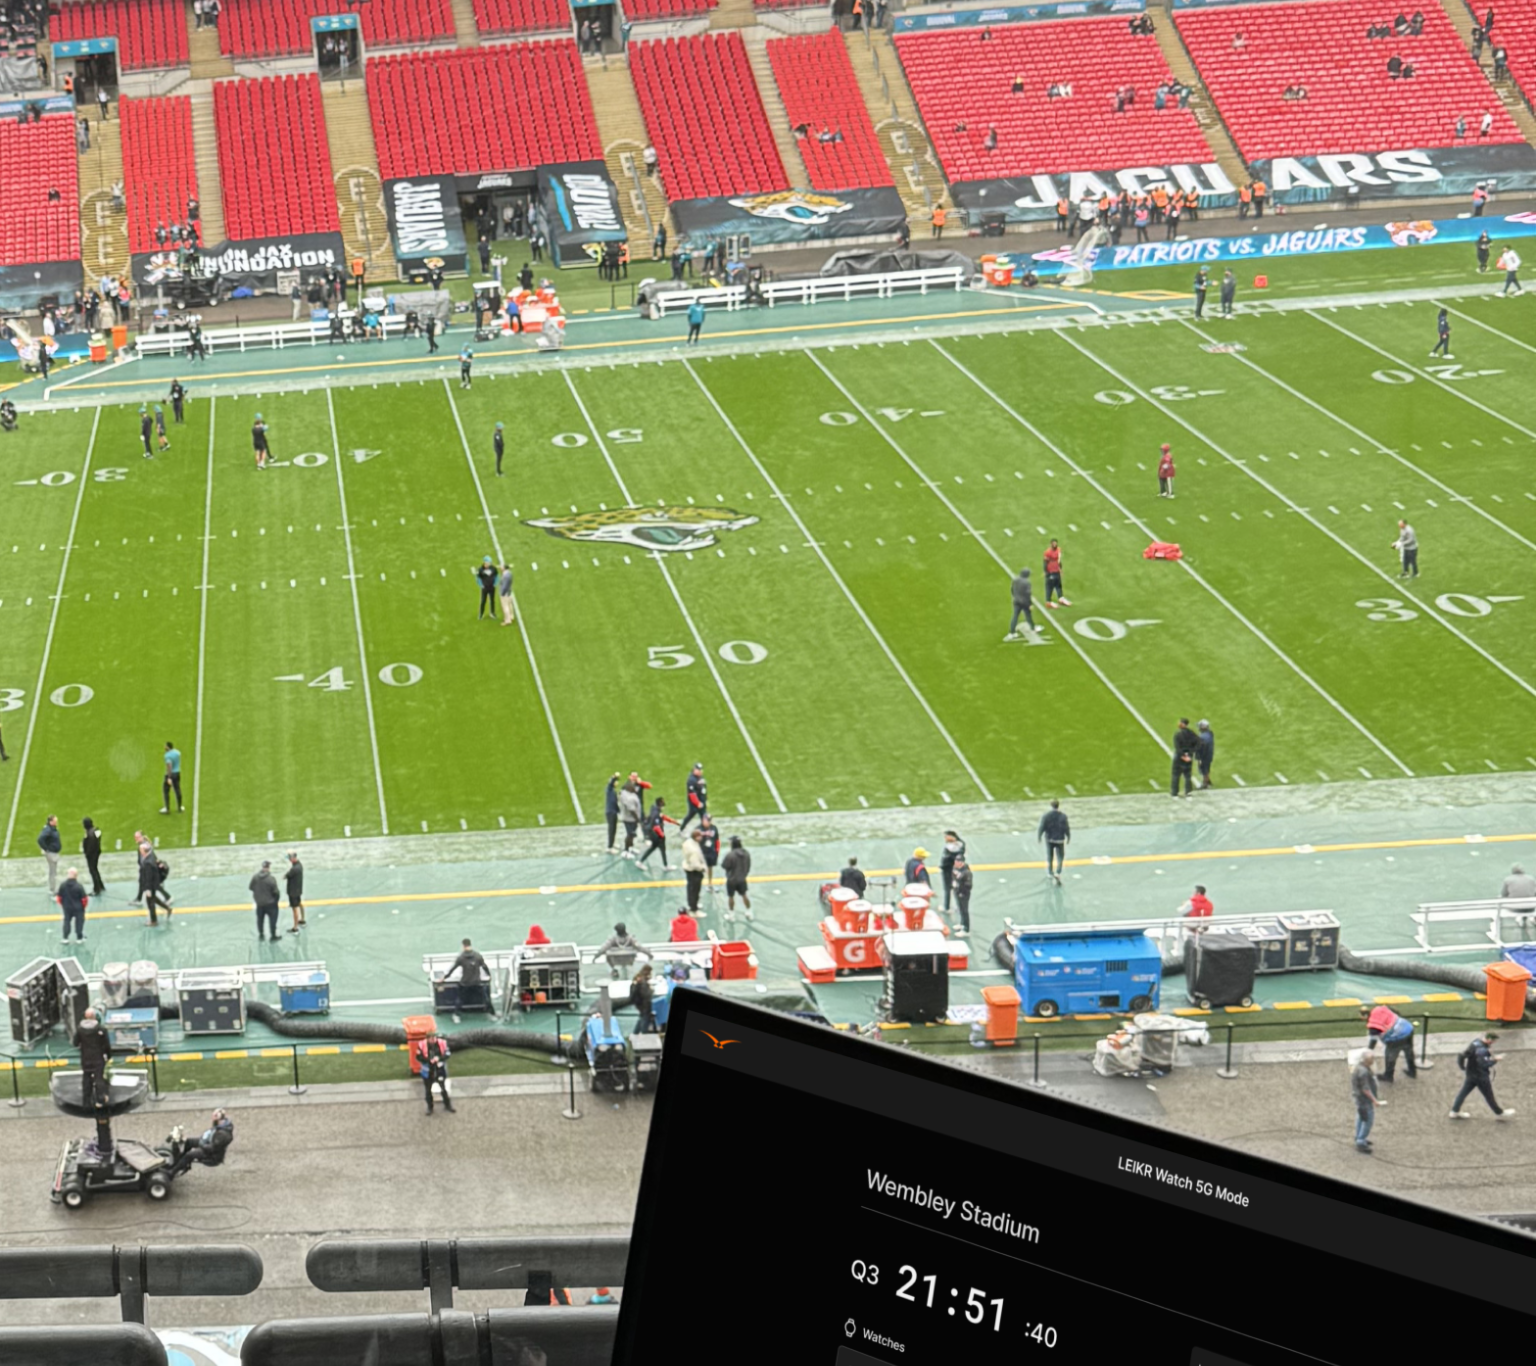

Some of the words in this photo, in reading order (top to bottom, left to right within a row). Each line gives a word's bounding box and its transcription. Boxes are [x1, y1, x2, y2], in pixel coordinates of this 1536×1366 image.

[393, 181, 449, 254] JAGUARS
[254, 243, 292, 259] JAX
[1113, 237, 1221, 265] PATRIOTS
[1262, 227, 1368, 256] JAGUARS
[843, 941, 866, 963] G
[1118, 1156, 1154, 1179] LEIKR
[1155, 1168, 1193, 1191] Watch
[1195, 1180, 1213, 1197] 5G
[1215, 1185, 1250, 1208] Mode
[867, 1169, 956, 1219] Wembley
[960, 1200, 1041, 1244] Stadium
[851, 1259, 880, 1286] Q3
[895, 1265, 1005, 1333] 21:51
[1024, 1321, 1058, 1349] :40
[863, 1327, 906, 1354] Watches
